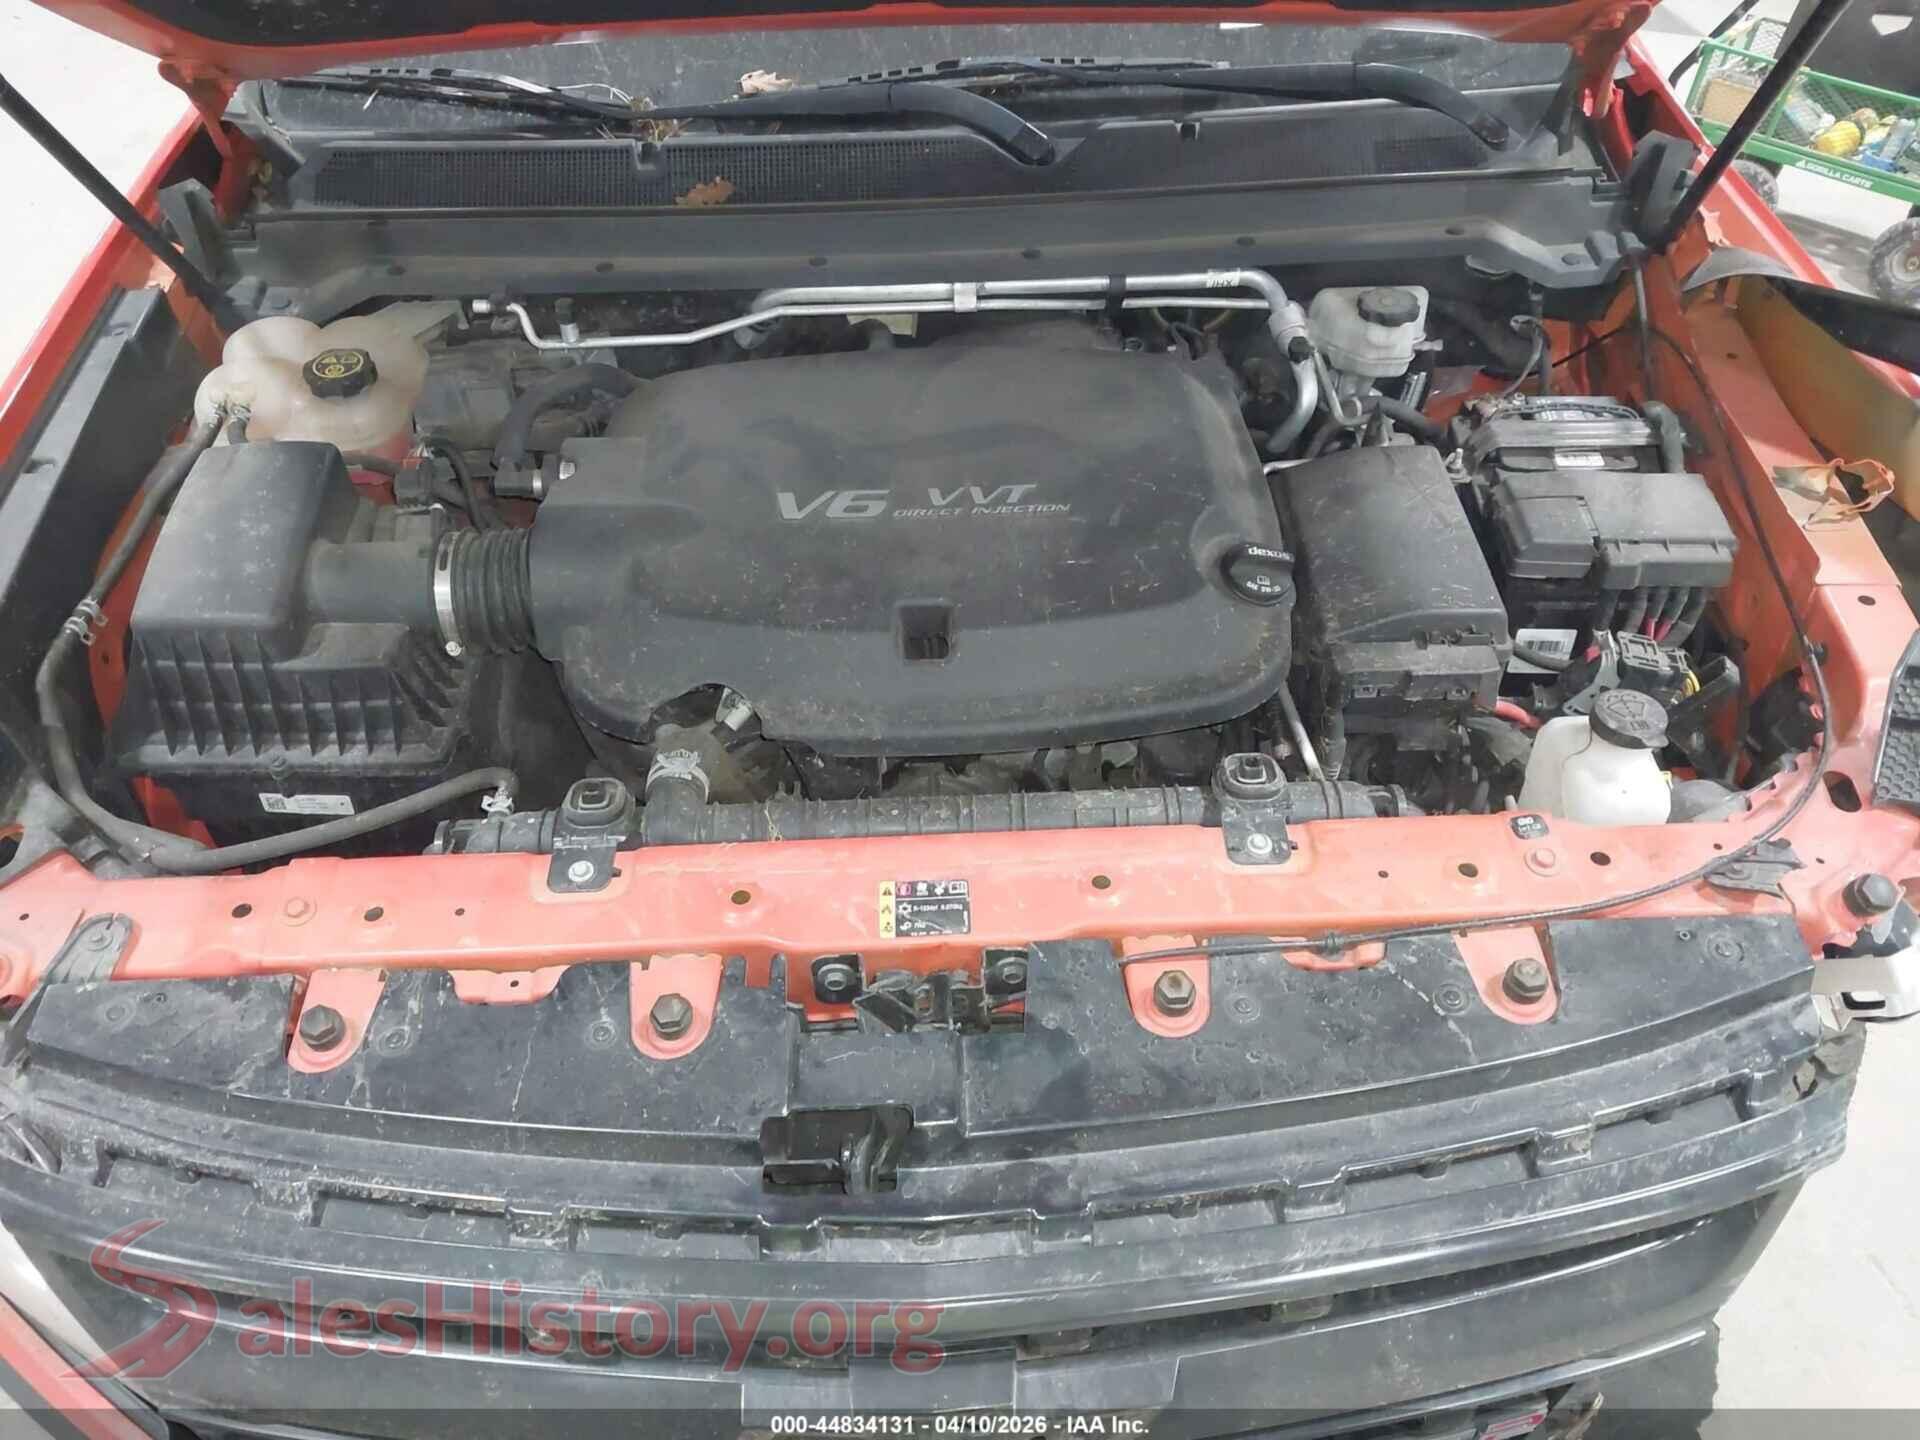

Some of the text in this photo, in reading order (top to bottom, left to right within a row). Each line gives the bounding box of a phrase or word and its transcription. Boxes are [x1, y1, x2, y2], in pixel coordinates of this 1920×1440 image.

[776, 489, 891, 520] V6
[927, 483, 1036, 506] VVT
[893, 502, 1071, 518] DIRECT INJECTION
